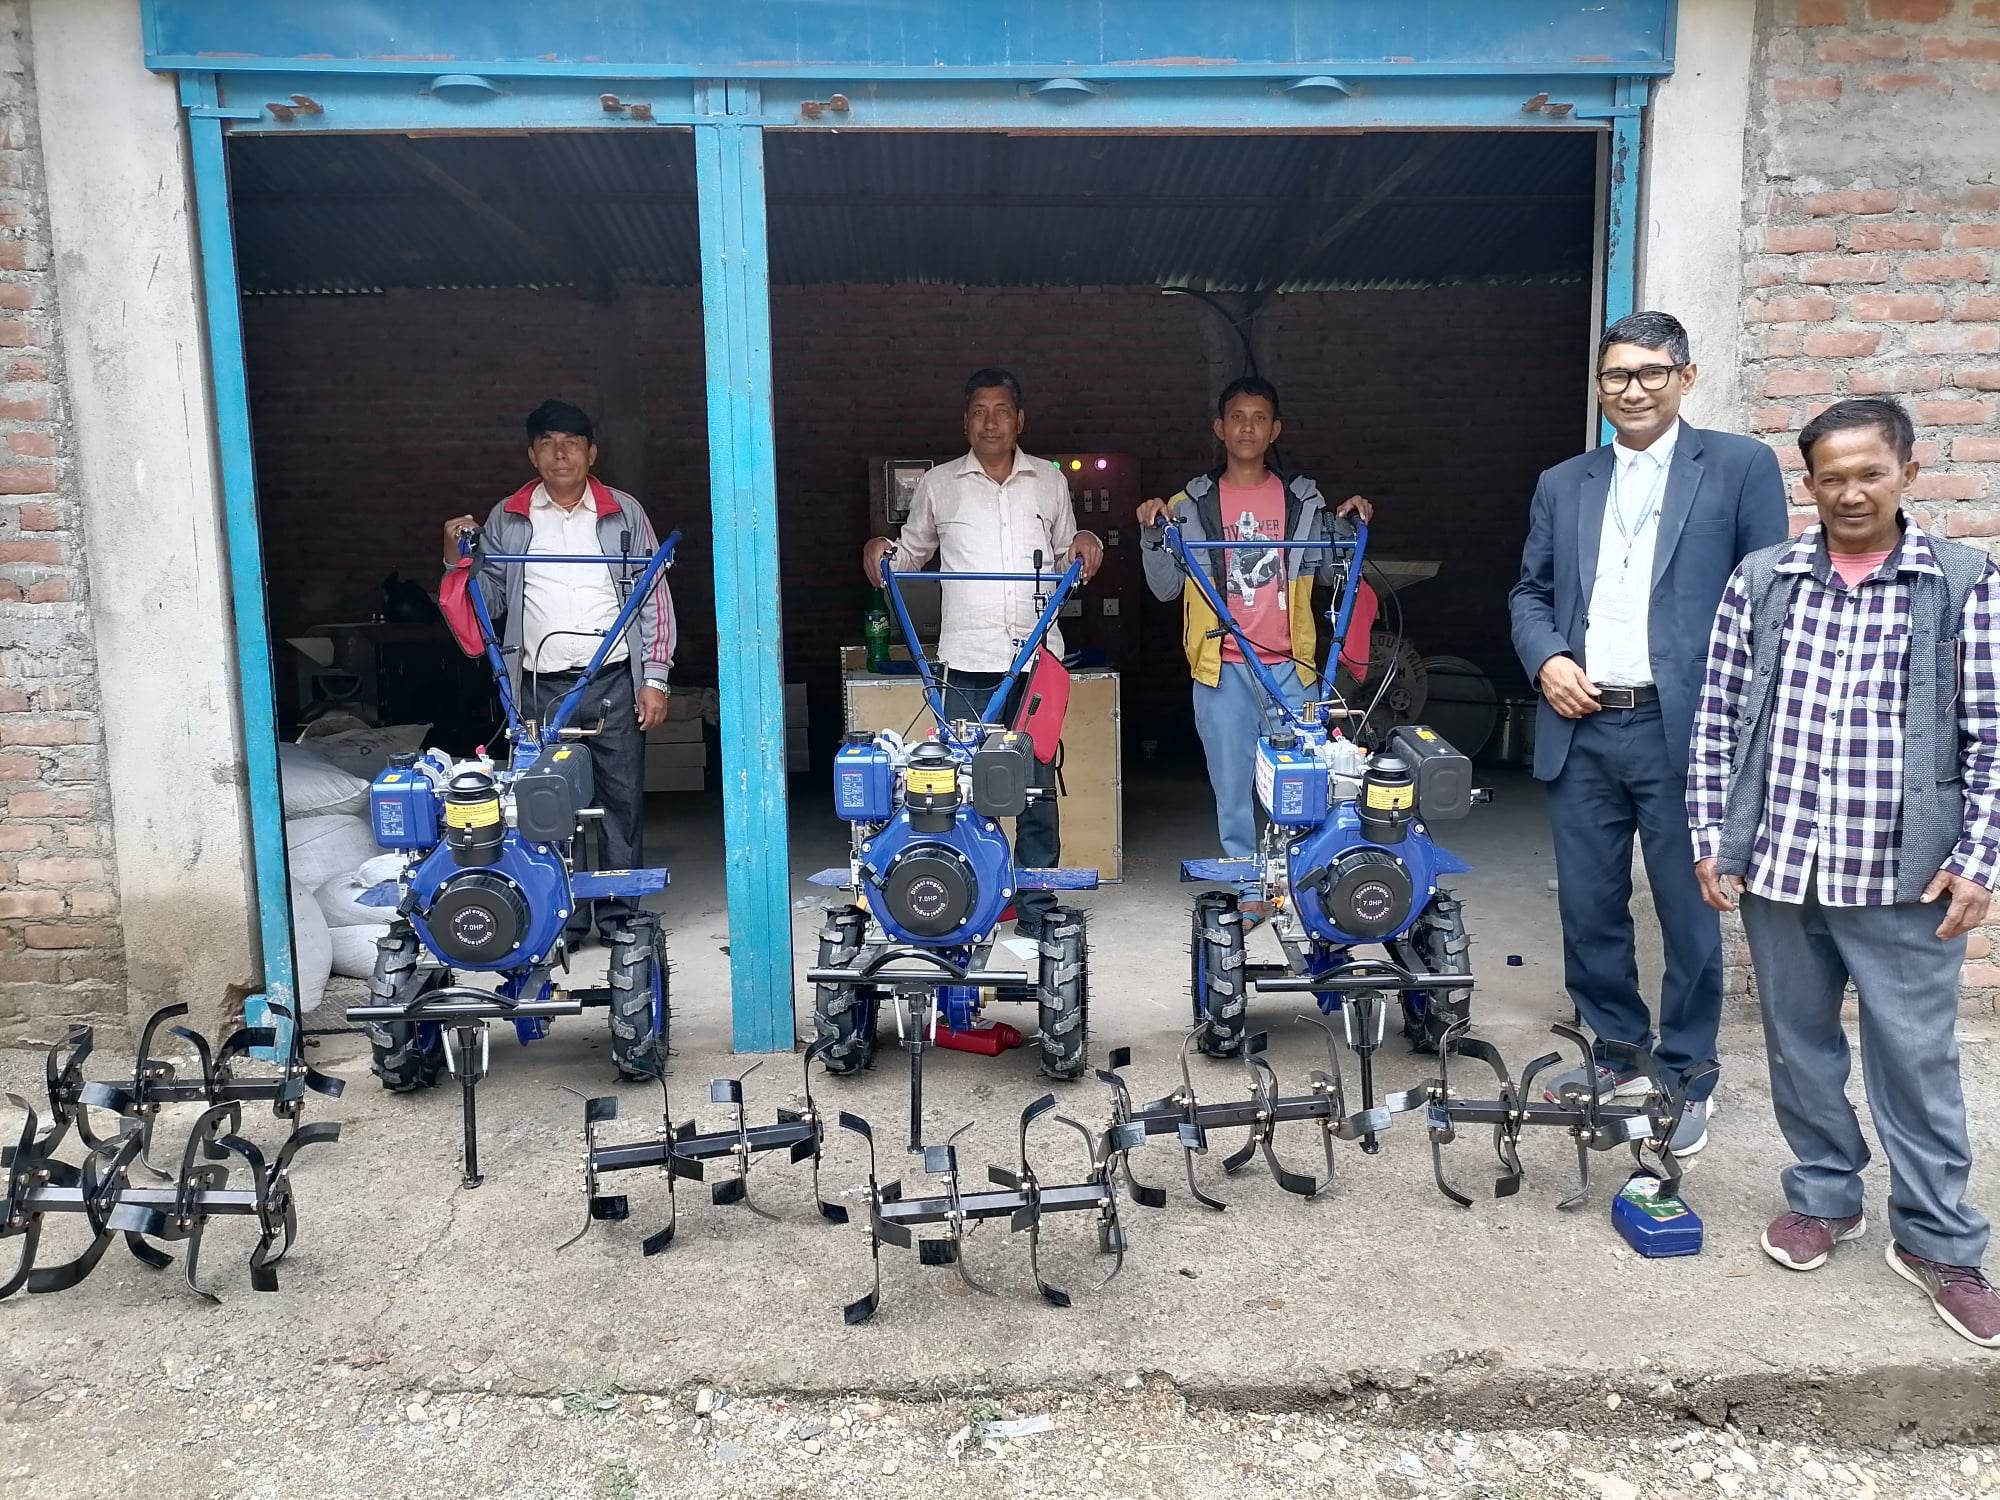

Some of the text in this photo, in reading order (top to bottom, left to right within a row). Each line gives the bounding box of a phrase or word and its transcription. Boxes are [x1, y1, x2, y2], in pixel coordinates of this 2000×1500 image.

[911, 880, 944, 895] Diesel engine
[1356, 885, 1389, 899] Diesel engine
[917, 895, 938, 903] 7.0HP
[1362, 899, 1383, 907] 7.0HP
[455, 909, 491, 923] Diesel engine
